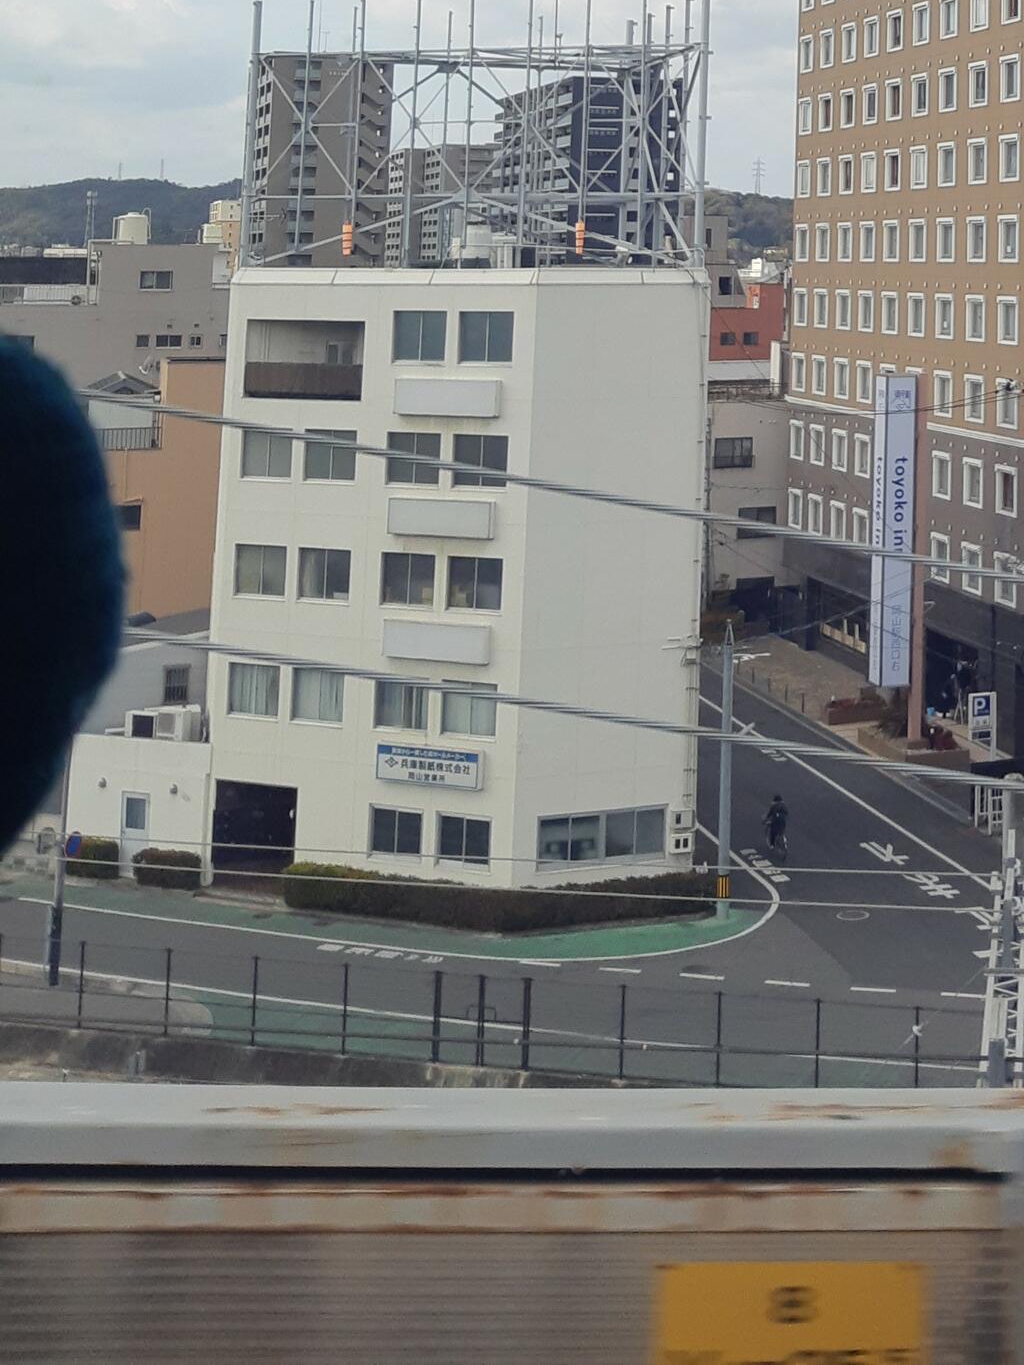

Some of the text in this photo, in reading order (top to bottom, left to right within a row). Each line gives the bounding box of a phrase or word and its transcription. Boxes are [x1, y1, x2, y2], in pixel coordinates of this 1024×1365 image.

[892, 456, 909, 523] toyoko
[974, 697, 986, 716] P
[400, 758, 471, 775] 兵庫製紙株式会社
[408, 771, 446, 783] 岡山営業所
